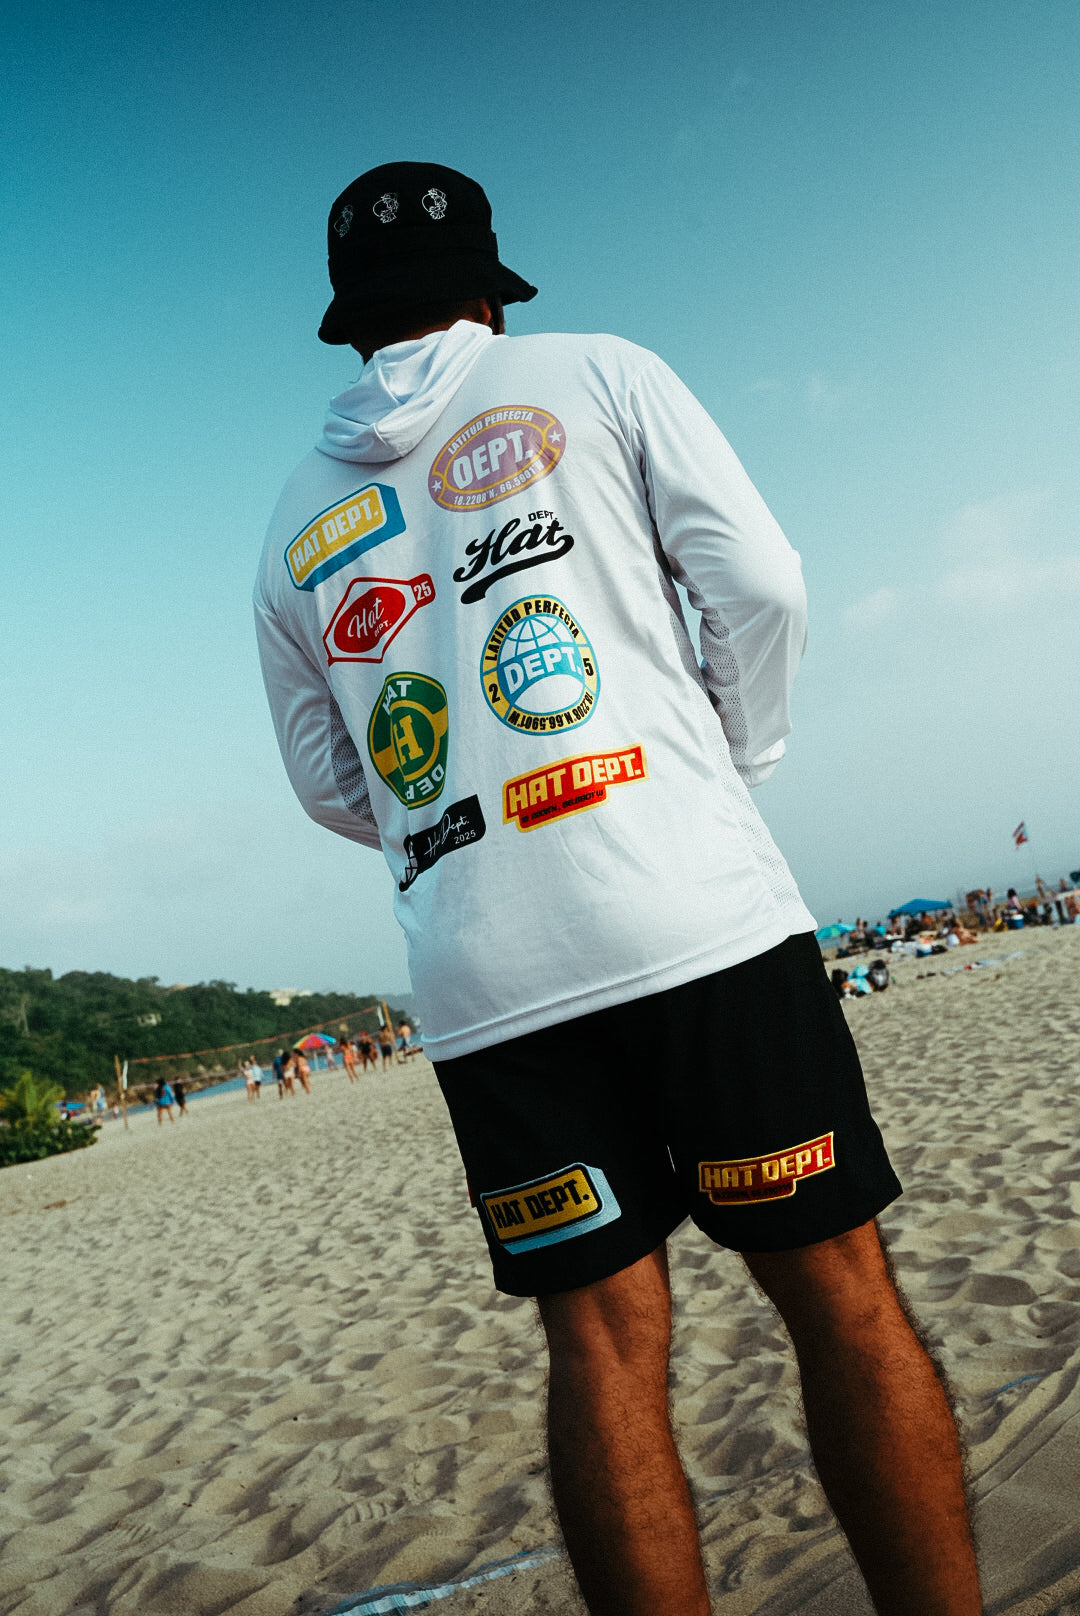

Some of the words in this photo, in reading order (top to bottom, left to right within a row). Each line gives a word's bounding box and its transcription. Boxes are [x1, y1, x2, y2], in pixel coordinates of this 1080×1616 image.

[448, 420, 483, 455] LATITUD
[485, 410, 534, 427] PERFECTA
[452, 429, 534, 490] DEPT.
[291, 529, 321, 572] HAT
[321, 497, 380, 545] DEPT.
[453, 518, 568, 583] Hat
[413, 580, 432, 601] 25
[347, 597, 385, 639] Hat
[485, 608, 521, 662] LATITUD
[523, 600, 580, 639] PERFECTA
[503, 646, 583, 695] DEPT.
[582, 657, 594, 677] 5
[488, 683, 501, 704] 2
[392, 714, 425, 761] H
[508, 767, 567, 814] HAT
[571, 752, 642, 790] DEPT.
[453, 829, 477, 845] 2025
[704, 1164, 757, 1188] HAT
[761, 1141, 830, 1183] DEPT.
[490, 1198, 526, 1229] HAT
[524, 1178, 590, 1220] DEPT.
